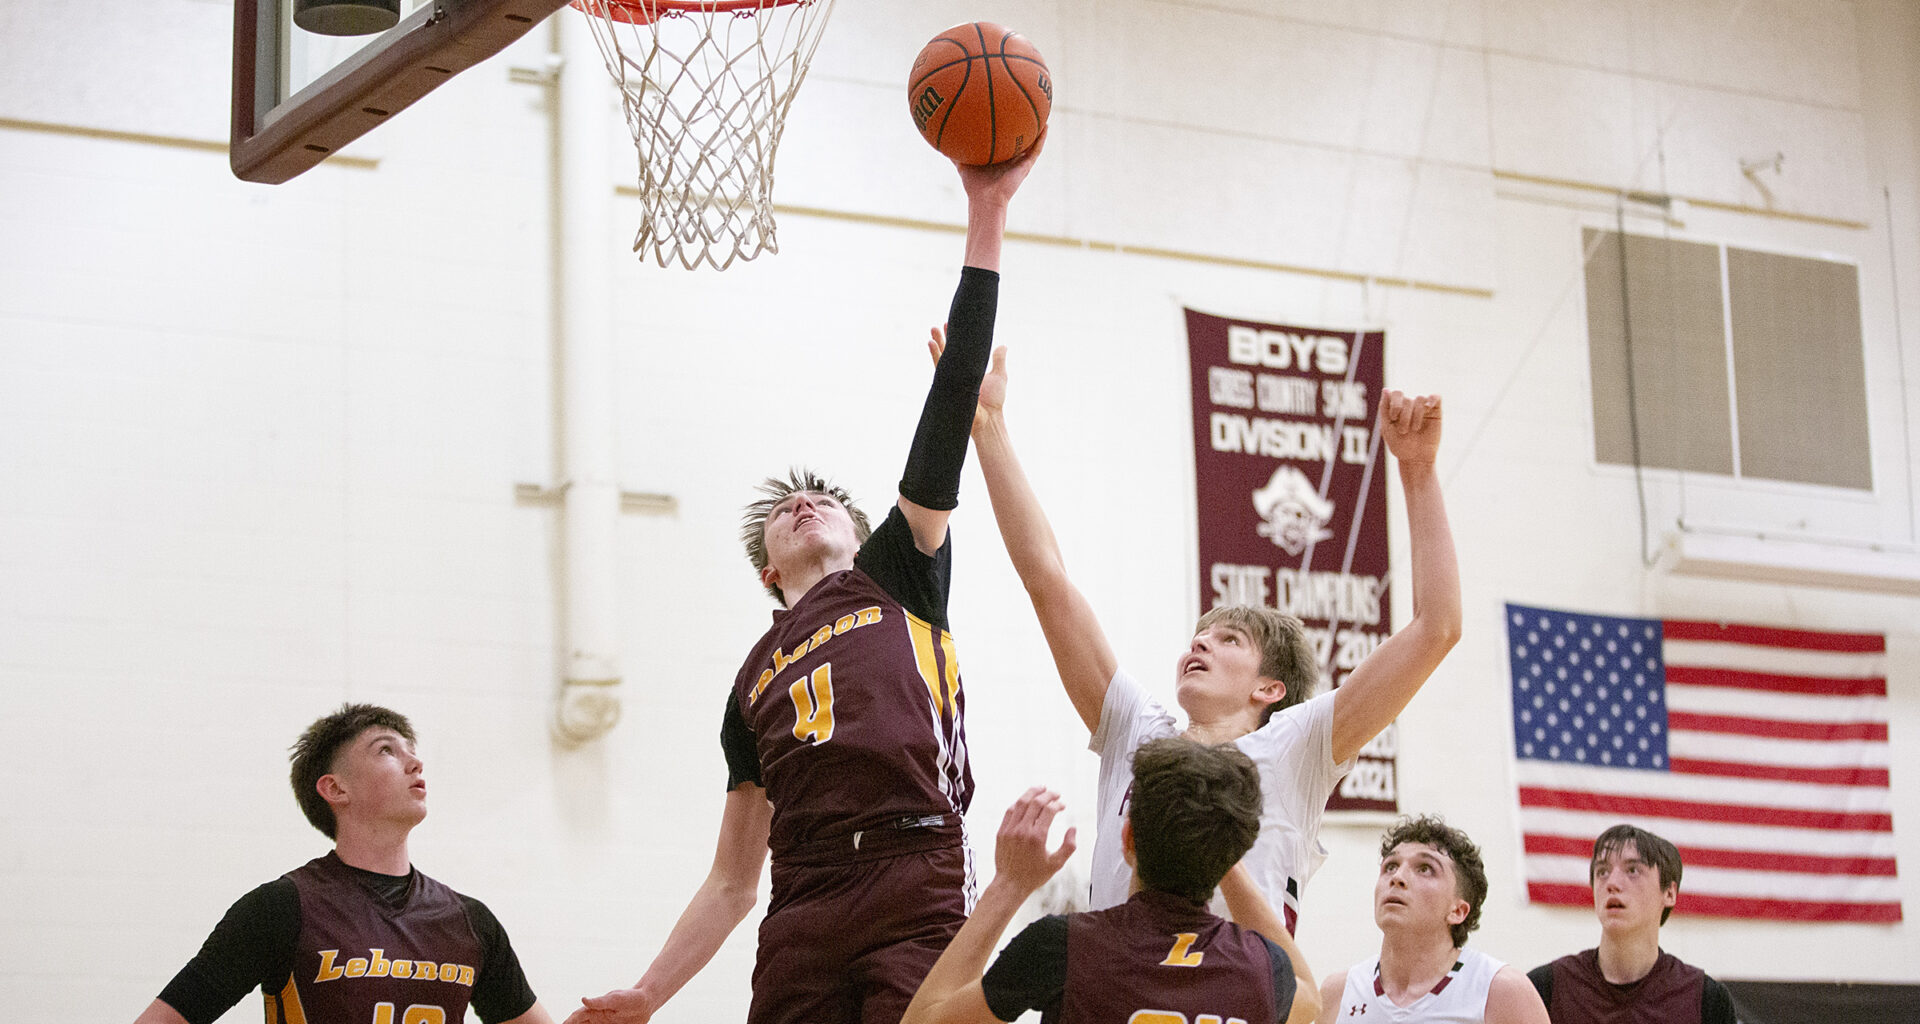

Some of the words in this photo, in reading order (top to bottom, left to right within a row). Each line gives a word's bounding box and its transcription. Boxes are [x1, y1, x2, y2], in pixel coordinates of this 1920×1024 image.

[1228, 325, 1348, 374] BOYS
[1210, 412, 1334, 461] DIVISION
[1211, 563, 1271, 607] STATE
[1276, 567, 1380, 625] CHAMPIONS
[789, 662, 835, 746] 4
[314, 948, 476, 986] Lebanon
[1159, 933, 1204, 967] L
